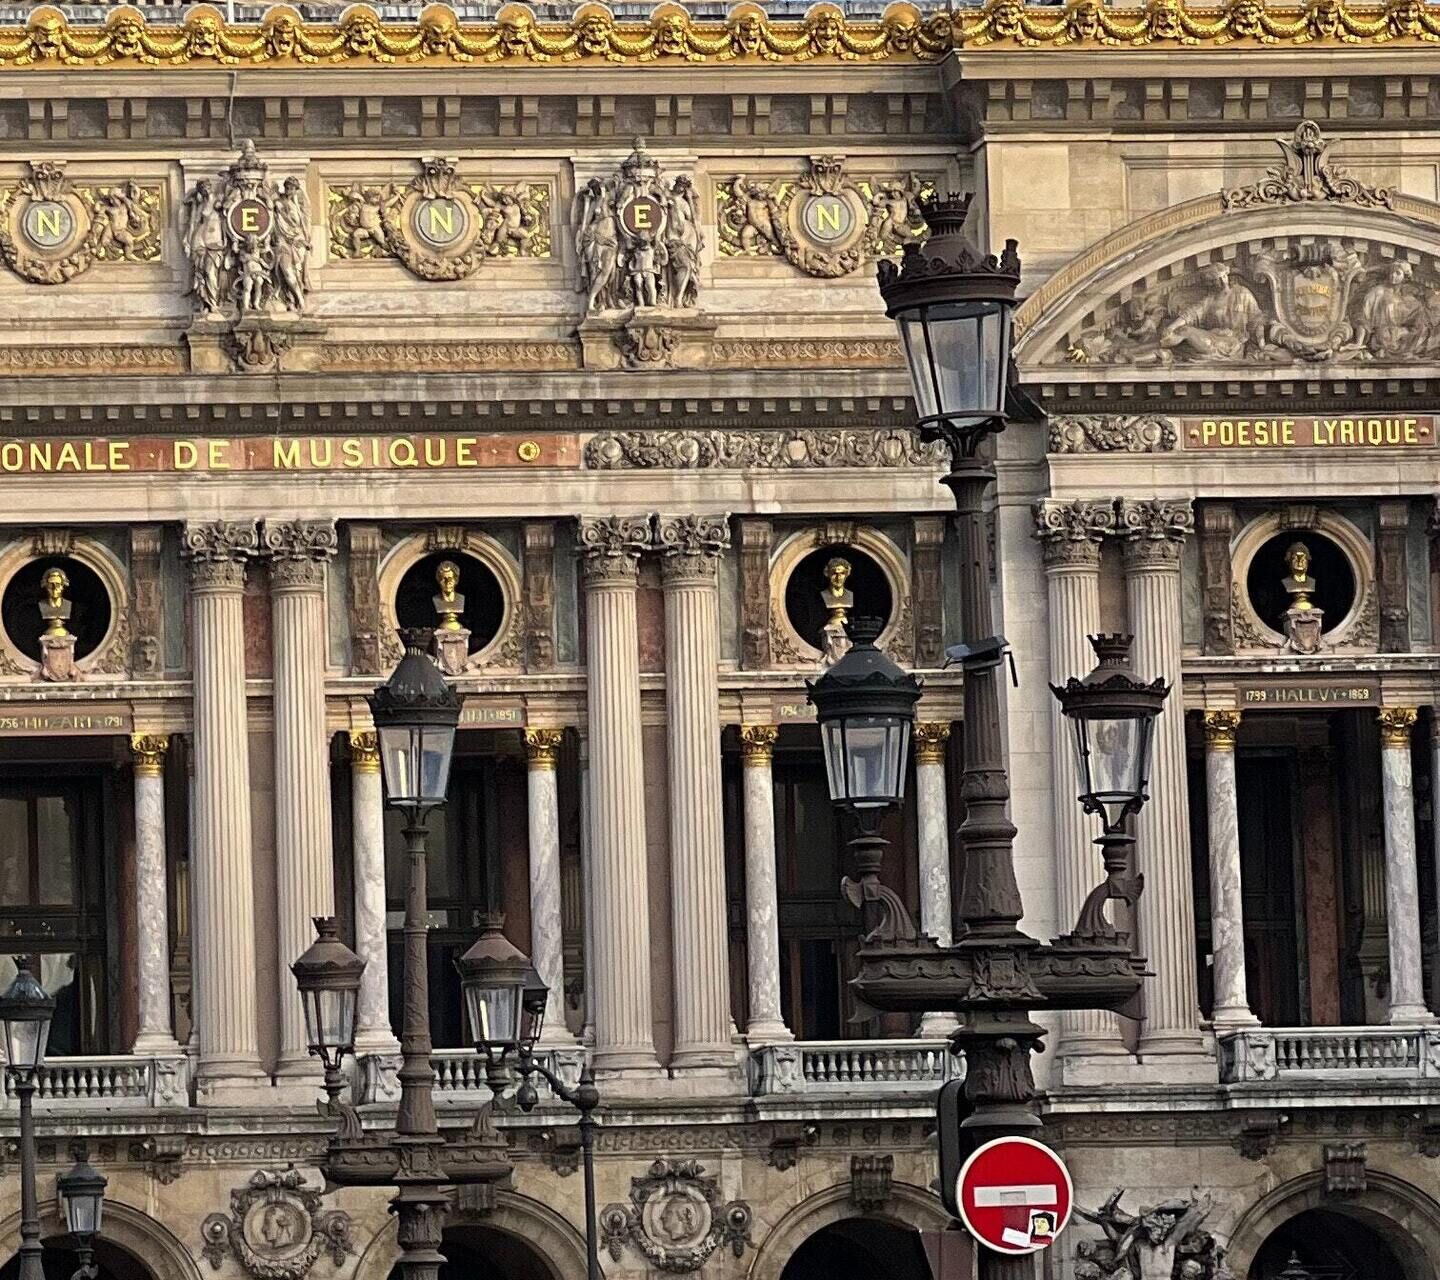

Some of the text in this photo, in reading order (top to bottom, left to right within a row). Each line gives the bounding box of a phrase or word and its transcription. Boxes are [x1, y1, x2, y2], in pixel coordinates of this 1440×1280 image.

[36, 209, 61, 237] N
[242, 208, 259, 232] E
[430, 206, 453, 233] N
[634, 205, 651, 229] E
[816, 203, 841, 231] N
[1202, 419, 1418, 446] POESIE LYRIQUE
[173, 440, 231, 469] DE
[273, 438, 478, 468] MUSIQUE
